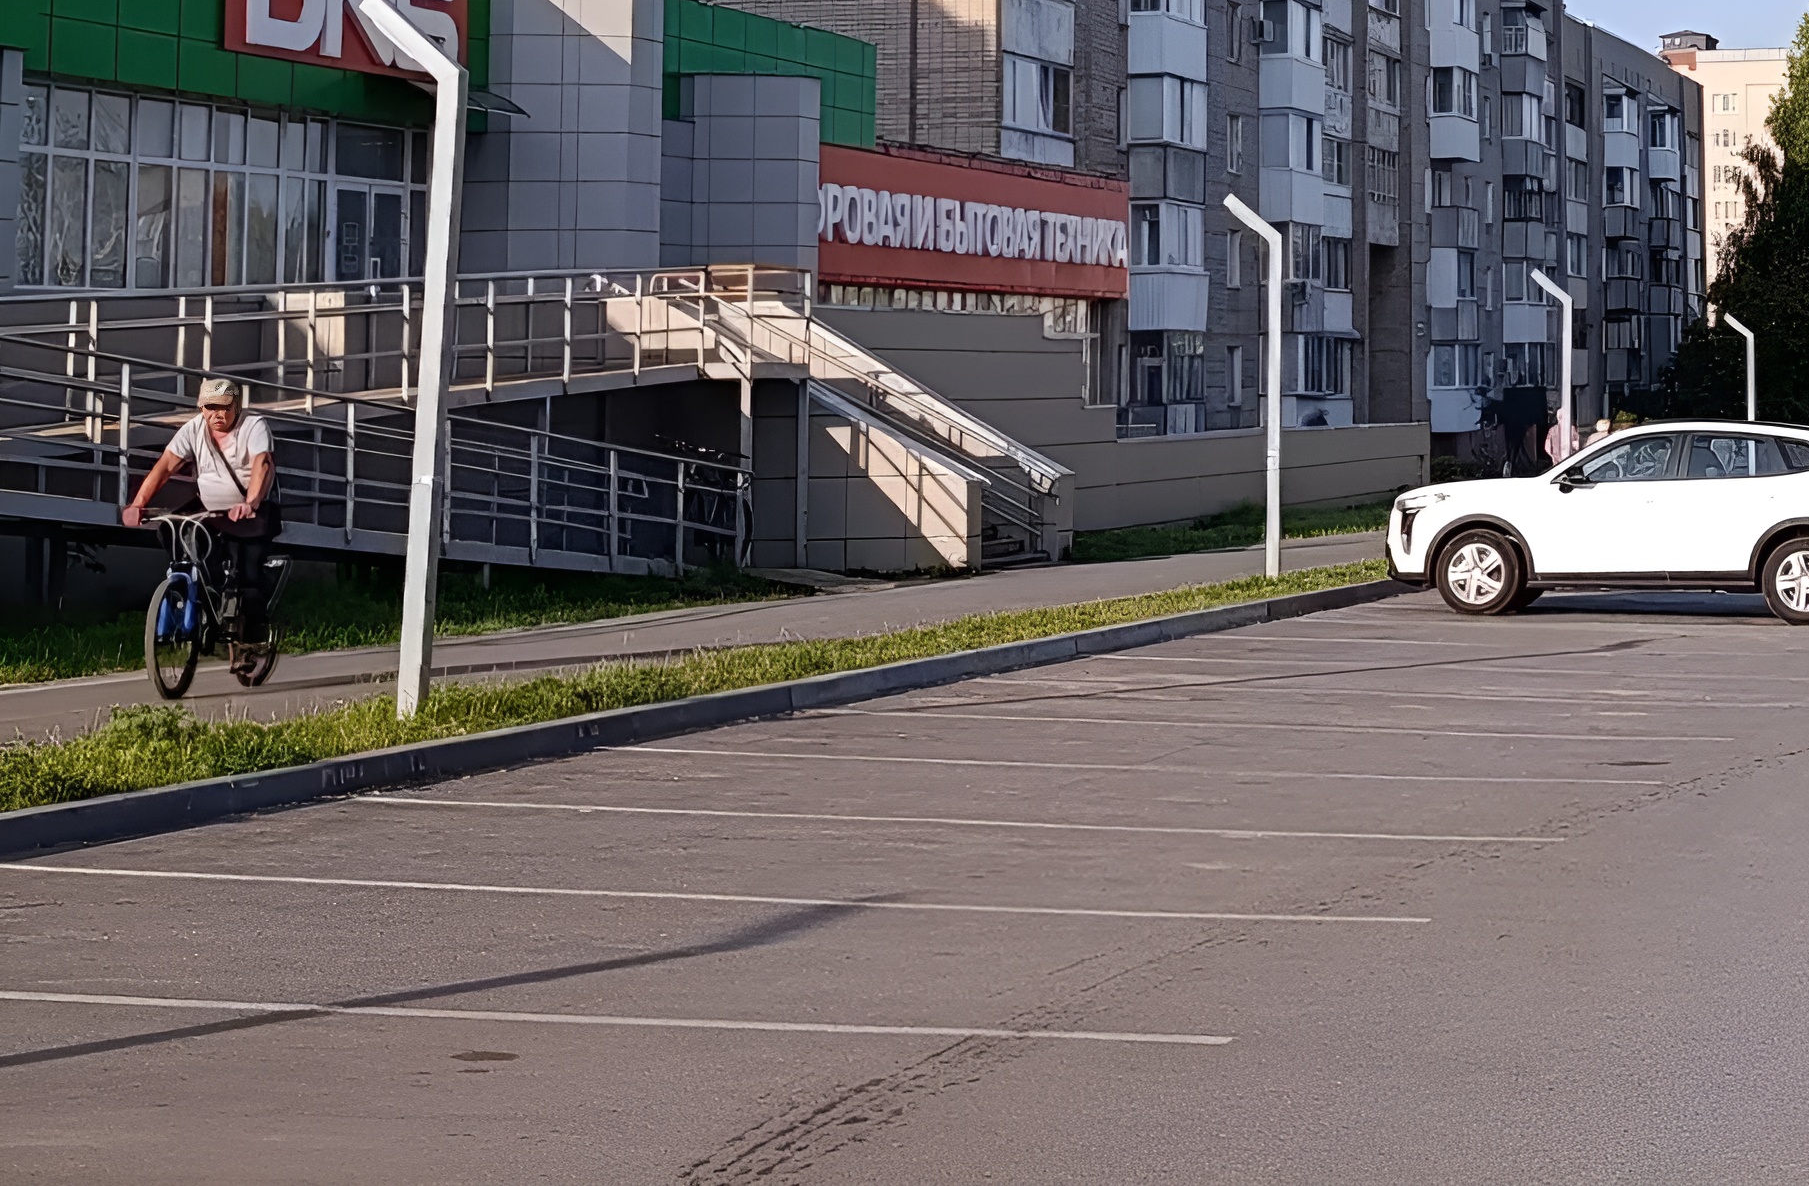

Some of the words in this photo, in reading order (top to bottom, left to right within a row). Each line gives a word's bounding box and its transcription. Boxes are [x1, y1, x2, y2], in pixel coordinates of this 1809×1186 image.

[912, 194, 934, 250] И
[937, 197, 1041, 260] БЫТОВАЯ
[1041, 211, 1128, 267] ТЕХНИКА
